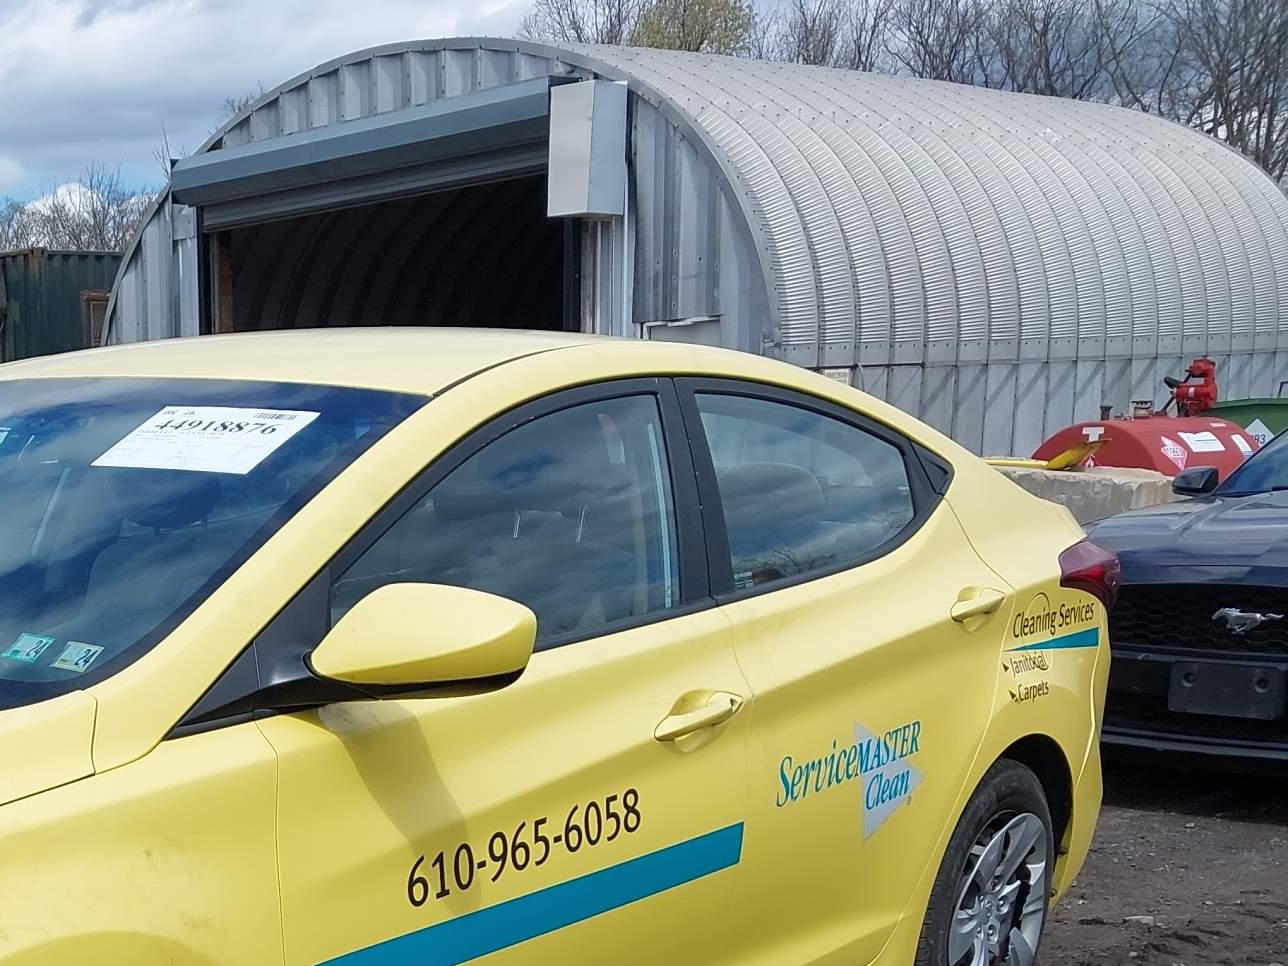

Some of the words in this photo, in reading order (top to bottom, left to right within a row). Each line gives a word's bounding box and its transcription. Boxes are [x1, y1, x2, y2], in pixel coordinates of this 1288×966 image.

[154, 418, 282, 436] 44918876
[1013, 607, 1057, 638] Cleaning
[1058, 599, 1094, 628] Services
[1010, 650, 1047, 678] Janitorial
[1018, 680, 1050, 703] Carpets
[865, 769, 910, 811] Clean
[407, 788, 642, 908] 610-965-6058
